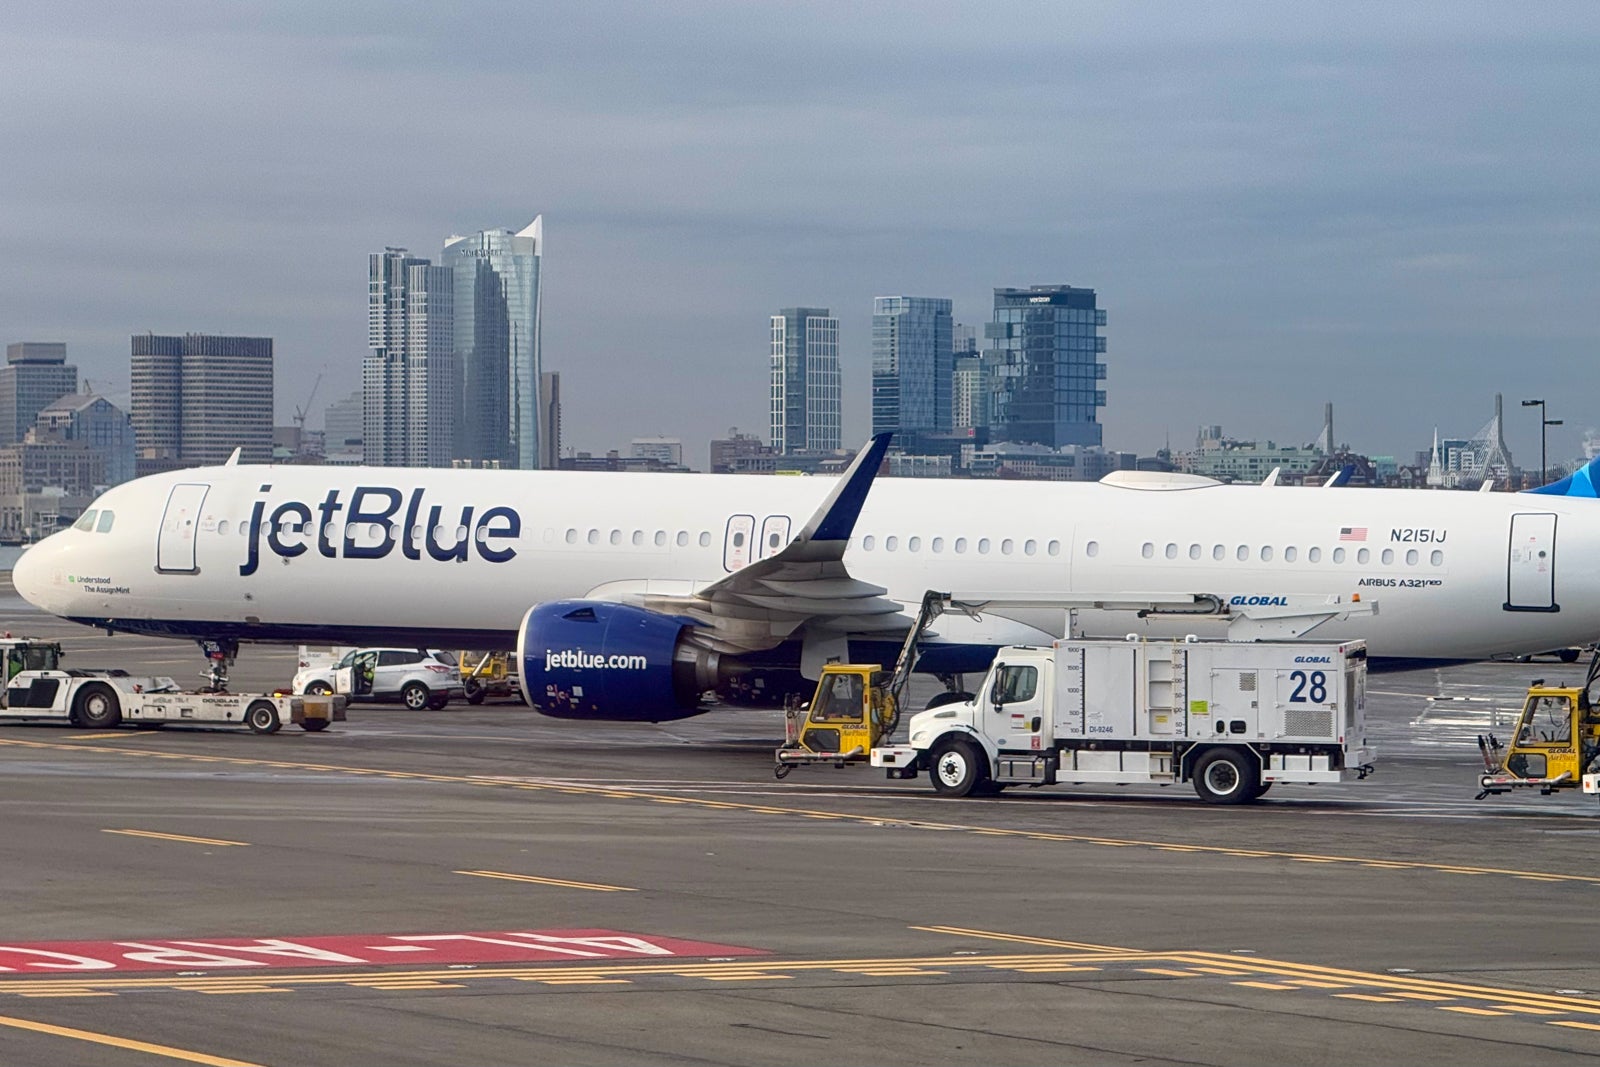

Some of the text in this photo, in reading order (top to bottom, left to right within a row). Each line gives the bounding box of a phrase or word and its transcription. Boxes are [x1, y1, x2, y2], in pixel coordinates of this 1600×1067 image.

[239, 483, 521, 577] jetBlue
[1390, 528, 1447, 543] N2151J
[77, 575, 111, 584] Understood
[1358, 578, 1443, 588] AIRBUS A321neo
[84, 585, 130, 595] The AssignMint
[1230, 595, 1288, 606] GLOBAL
[544, 649, 647, 672] jetblue.com
[1294, 656, 1331, 664] GLOBAL
[1289, 670, 1327, 704] 28
